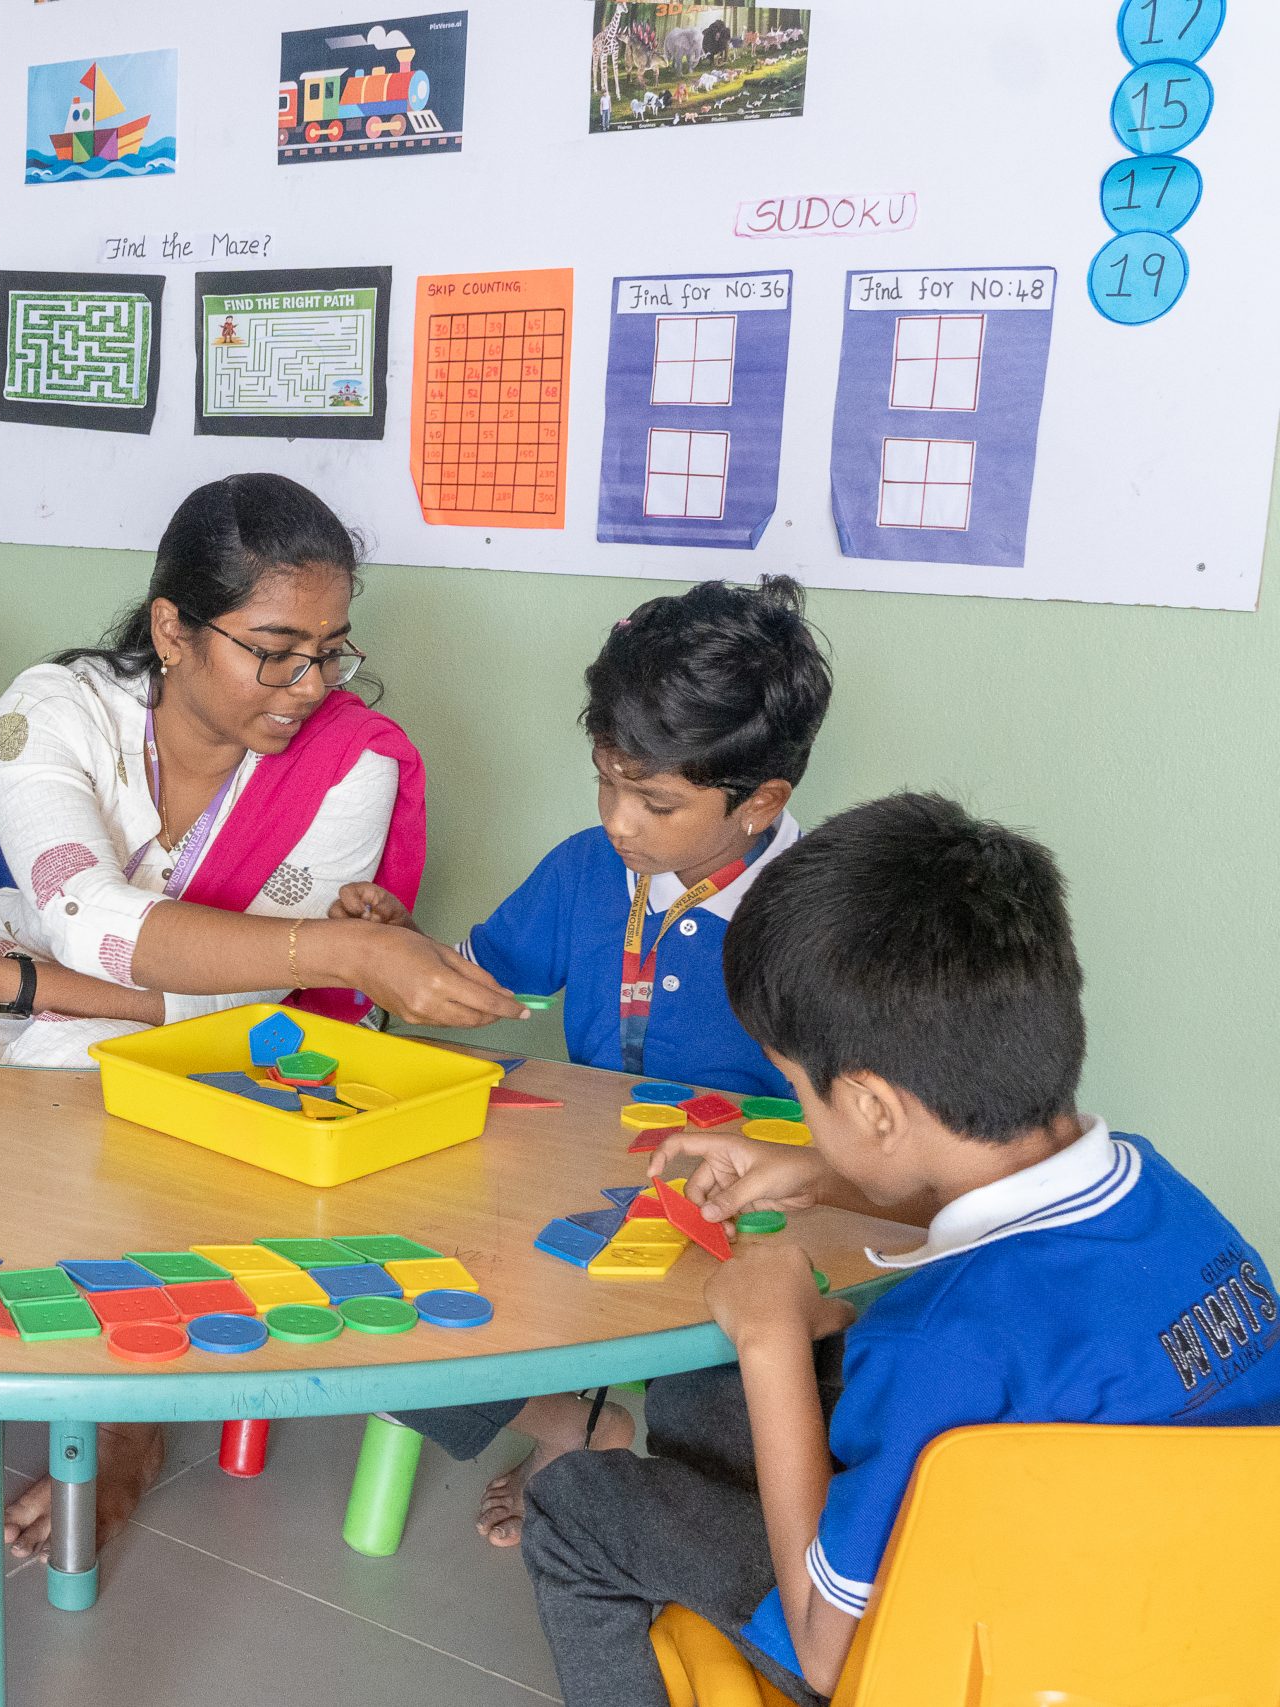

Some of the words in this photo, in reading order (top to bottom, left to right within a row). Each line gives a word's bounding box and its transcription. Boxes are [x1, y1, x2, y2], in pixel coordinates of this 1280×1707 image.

[1127, 77, 1192, 132] 15
[1112, 165, 1177, 210] 17
[747, 194, 907, 232] SUDOKU
[105, 235, 146, 259] Find
[162, 232, 193, 259] the
[211, 233, 272, 258] Maze?
[428, 284, 456, 297] SKIP
[859, 277, 903, 303] Find
[1105, 252, 1166, 298] 19
[224, 299, 254, 311] FIND
[256, 298, 280, 310] THE
[282, 296, 321, 309] RIGHT
[323, 294, 355, 307] PATH
[629, 284, 670, 309] Find
[545, 387, 557, 398] 68
[165, 851, 192, 892] WISDOM
[186, 812, 210, 853] WEALTH
[673, 882, 709, 909] WEALTH
[626, 910, 638, 948] WISDOM
[1201, 1240, 1244, 1284] GLOBAL
[1160, 1261, 1277, 1391] WWIS
